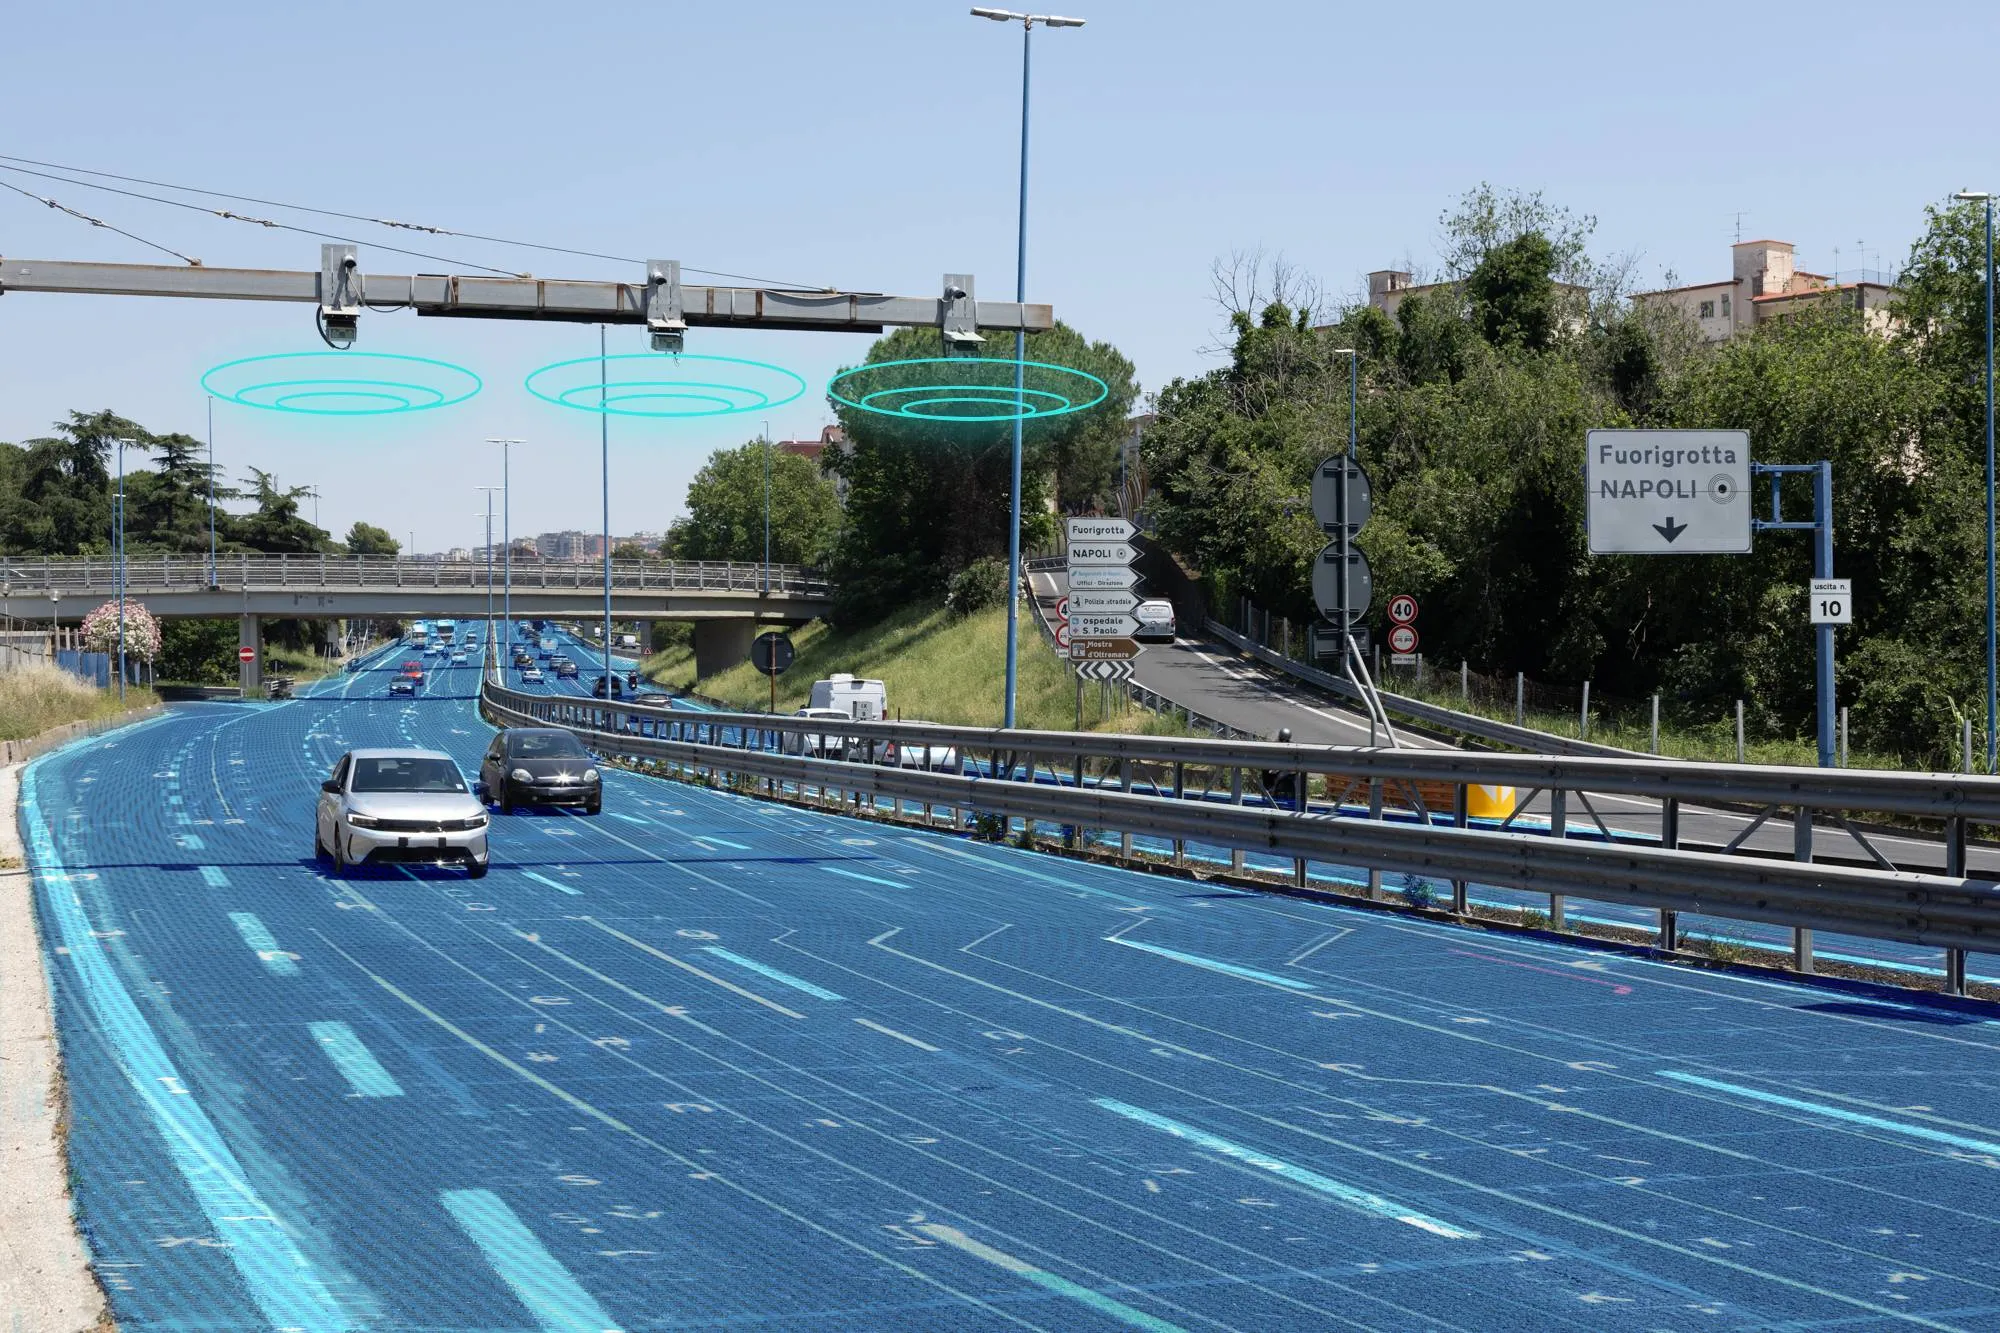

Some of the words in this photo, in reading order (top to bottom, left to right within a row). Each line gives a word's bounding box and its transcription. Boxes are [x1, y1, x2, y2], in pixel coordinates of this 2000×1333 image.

[1600, 445, 1736, 468] Fuorigrotta
[1600, 479, 1696, 499] NAPOLI
[1072, 525, 1125, 535] Fuorigrotta
[1073, 549, 1111, 558] NAPOLI
[1061, 604, 1068, 616] 4
[1394, 603, 1412, 616] 40
[1820, 600, 1842, 617] 10
[1082, 617, 1124, 627] ospedale
[1082, 627, 1091, 635] S.
[1093, 627, 1118, 635] Paolo
